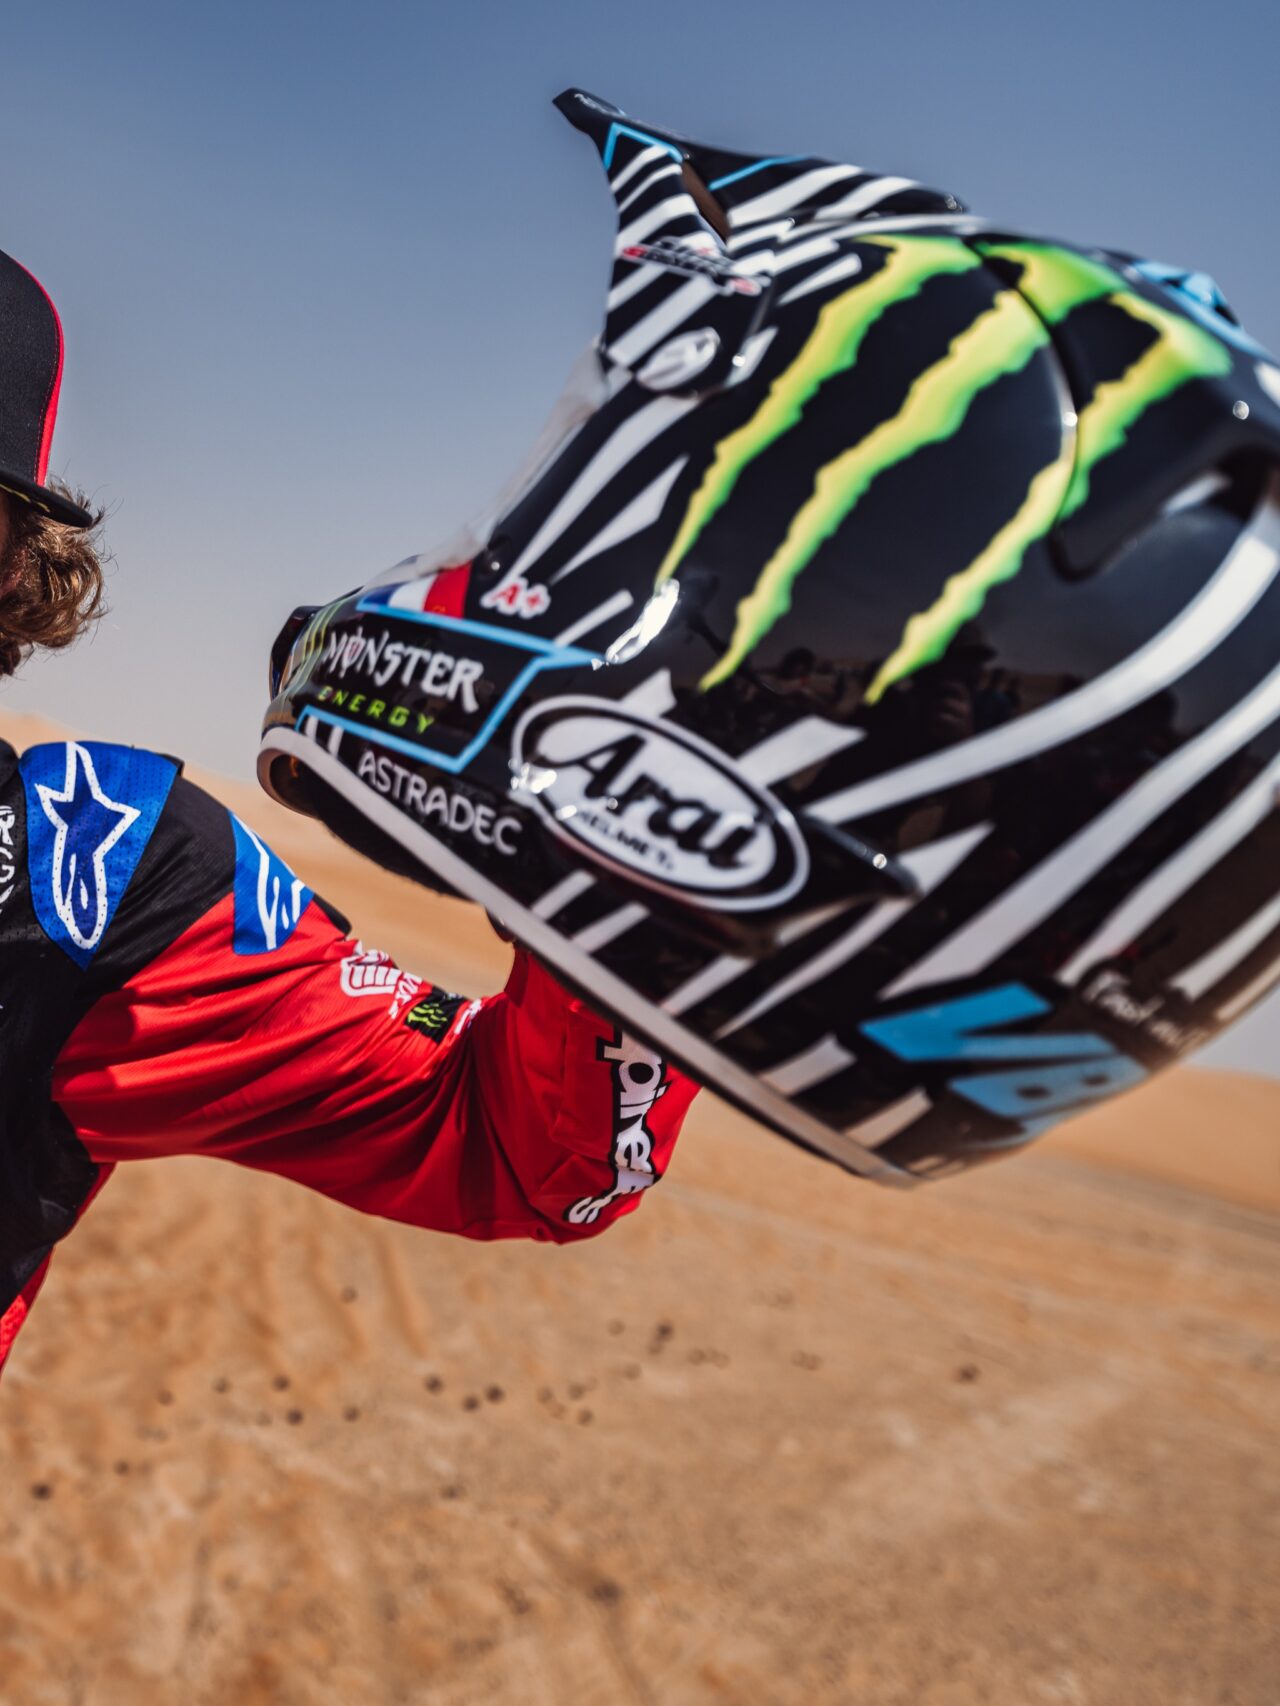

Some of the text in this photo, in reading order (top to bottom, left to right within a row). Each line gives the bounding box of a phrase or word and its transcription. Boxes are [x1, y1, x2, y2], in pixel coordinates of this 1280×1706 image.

[318, 685, 435, 735] ENERGY
[321, 625, 485, 714] MONSTER
[357, 749, 522, 856] ASTRADEC
[535, 733, 773, 868] Arai
